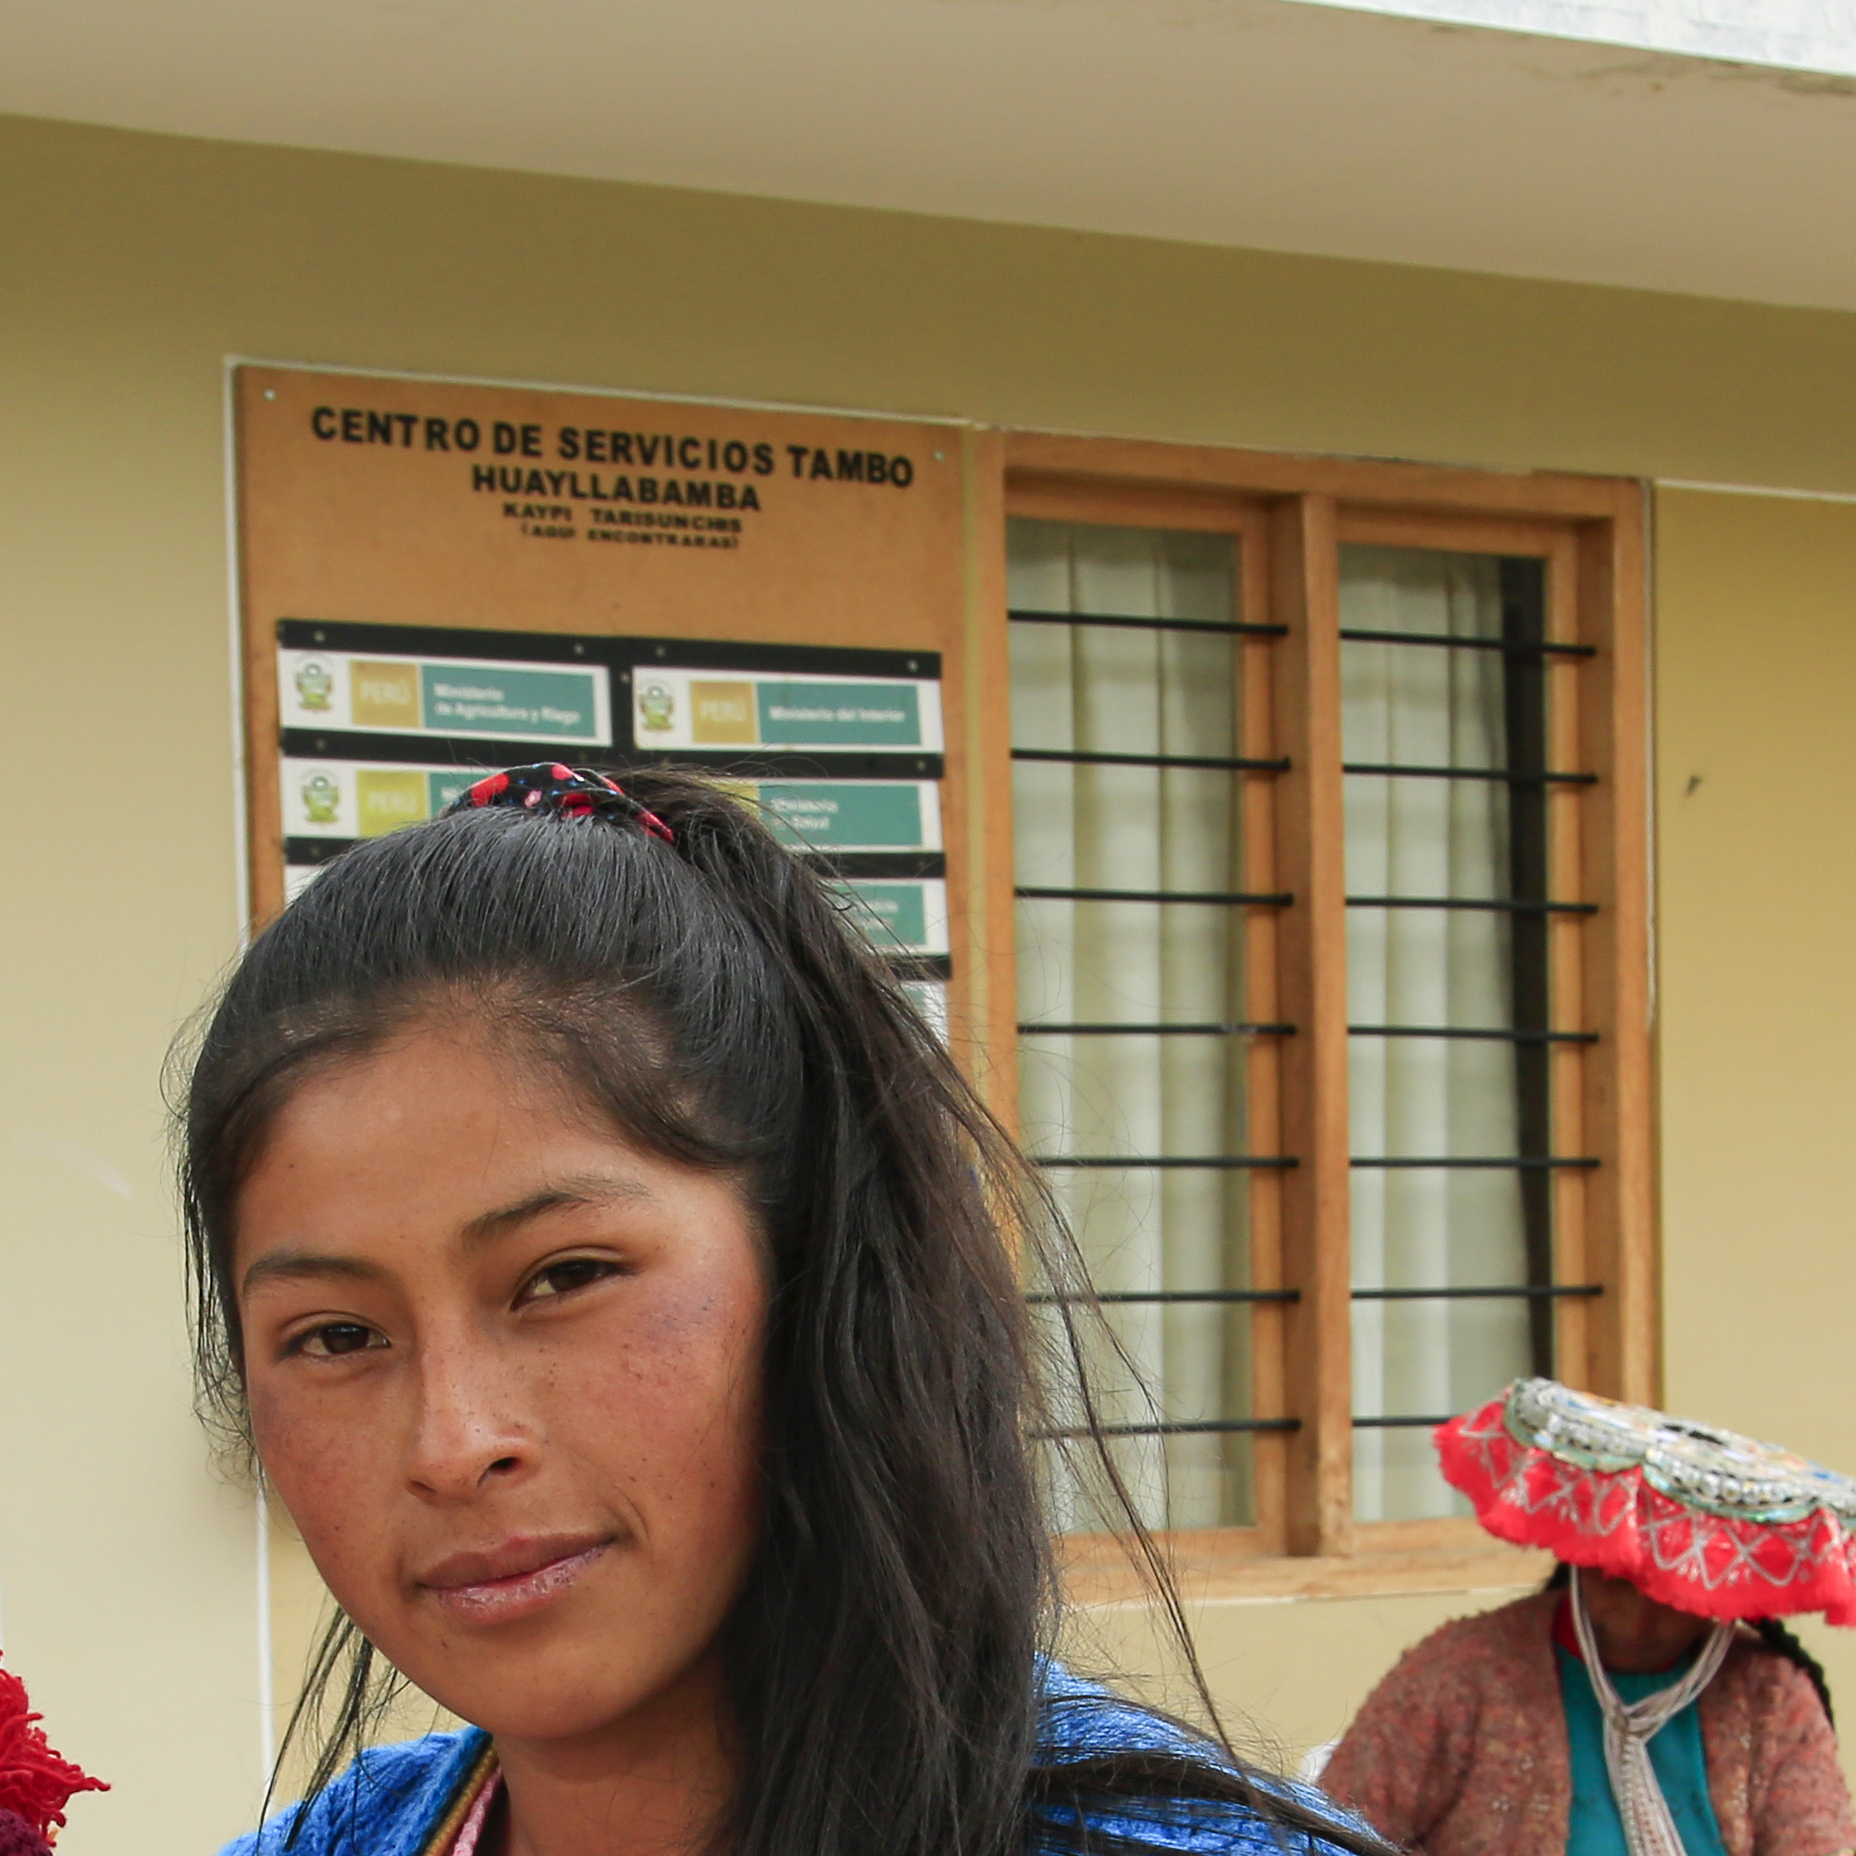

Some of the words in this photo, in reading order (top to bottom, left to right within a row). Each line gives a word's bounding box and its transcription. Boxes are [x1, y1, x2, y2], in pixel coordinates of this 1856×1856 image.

[311, 405, 481, 452] CENTRO
[492, 420, 543, 457] DE
[557, 426, 775, 476] SERVICIOS
[784, 443, 914, 488] TAMBO
[471, 462, 762, 512] HUAYLLABAMBA
[502, 502, 573, 522] KAYPI
